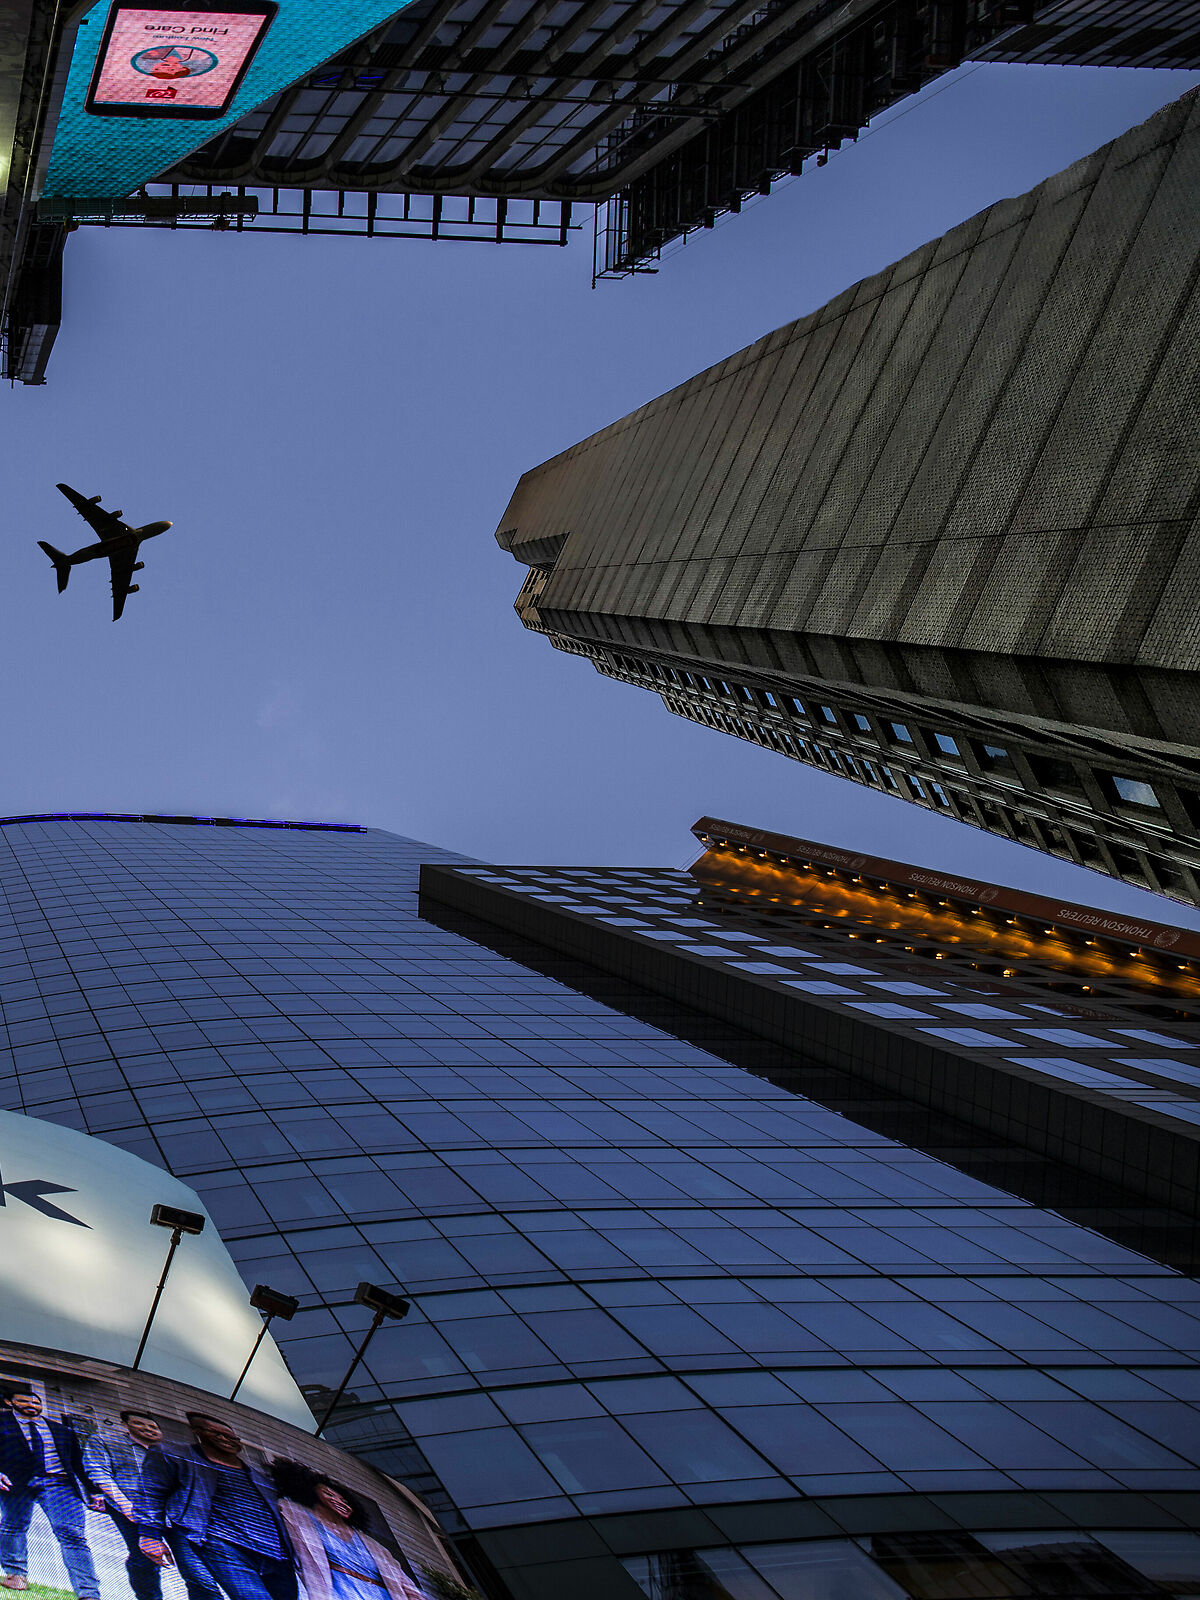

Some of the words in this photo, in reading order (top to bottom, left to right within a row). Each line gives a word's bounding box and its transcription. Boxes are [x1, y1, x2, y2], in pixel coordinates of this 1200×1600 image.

[144, 25, 186, 34] Care
[190, 26, 229, 35] Find
[909, 873, 942, 886] REUTERS
[940, 880, 979, 895] THOMSON
[1057, 909, 1102, 926] REUTERS
[1100, 919, 1153, 938] THOMSON
